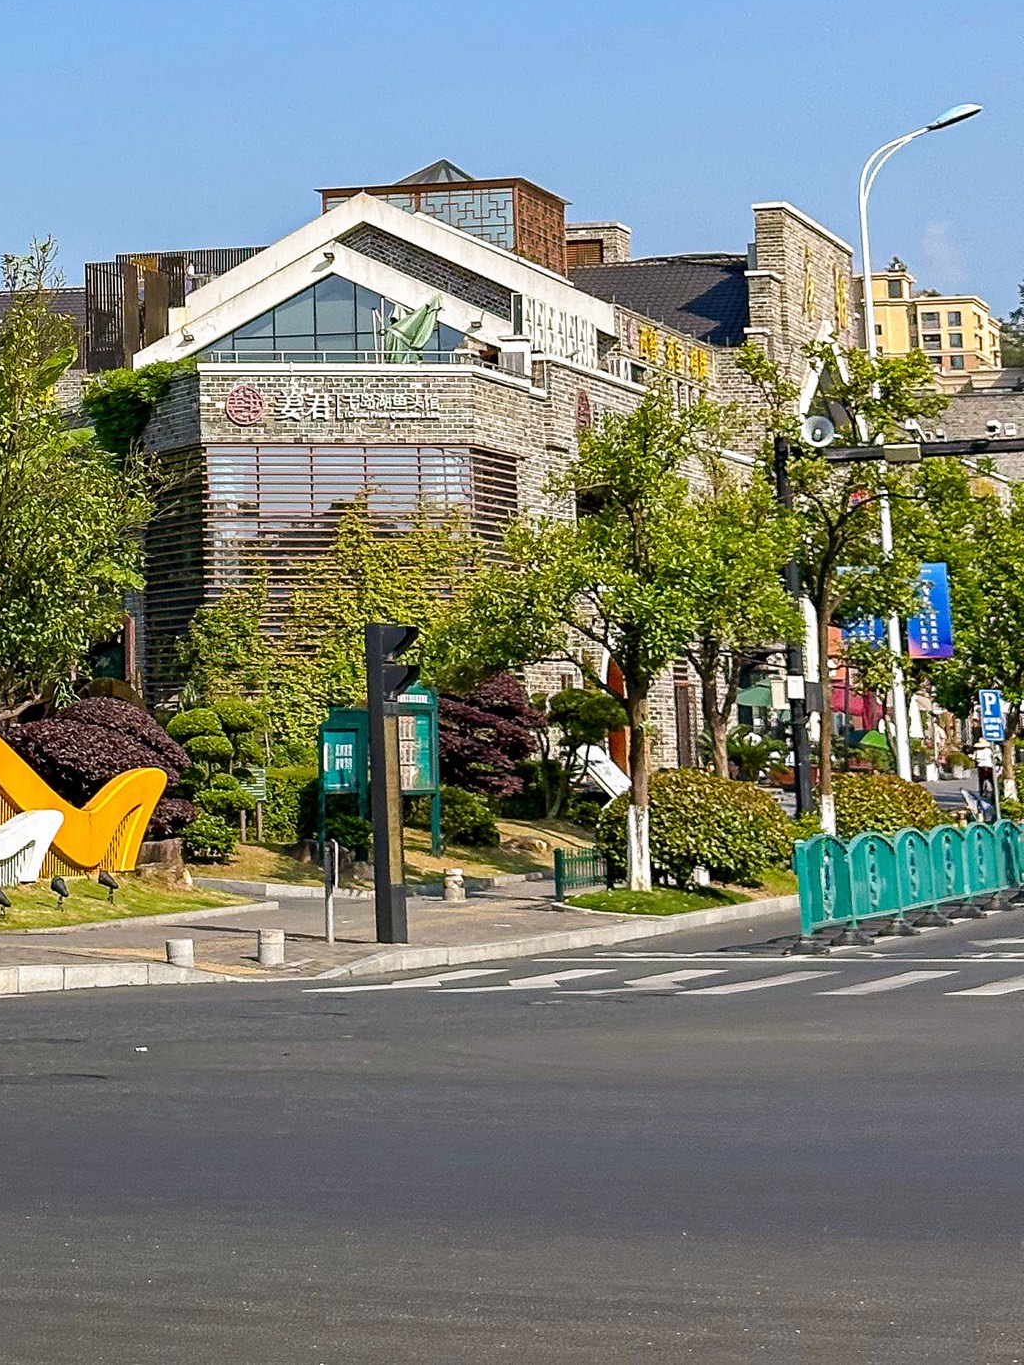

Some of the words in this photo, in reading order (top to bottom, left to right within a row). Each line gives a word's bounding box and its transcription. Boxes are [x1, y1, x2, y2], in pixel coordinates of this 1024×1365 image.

[342, 393, 440, 410] 千岛湖鱼头馆
[983, 692, 997, 715] P
